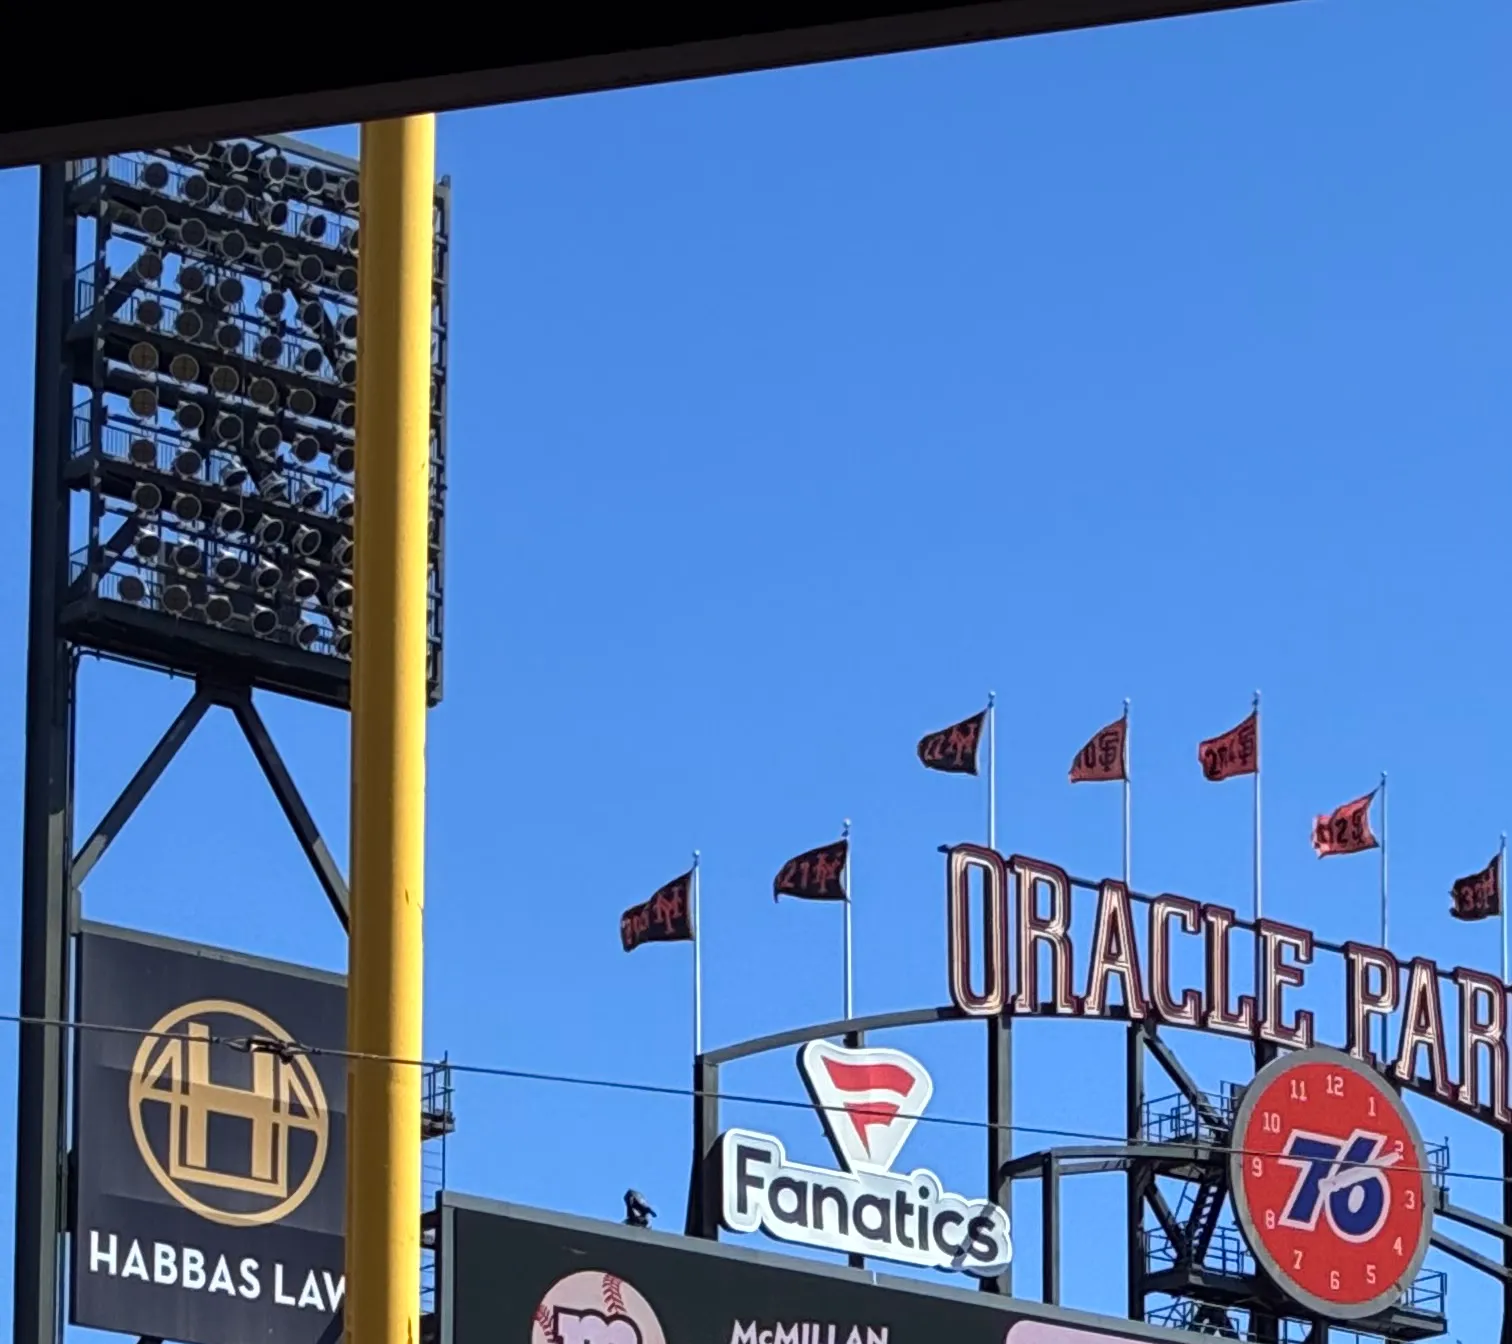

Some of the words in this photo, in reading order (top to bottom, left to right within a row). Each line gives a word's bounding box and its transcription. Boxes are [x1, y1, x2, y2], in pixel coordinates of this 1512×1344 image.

[946, 842, 1313, 1050] ORACLE
[1290, 1080, 1307, 1100] 11
[1326, 1074, 1344, 1095] 12
[1263, 1113, 1281, 1133] 10
[1252, 1157, 1263, 1177] 9
[1277, 1126, 1390, 1245] 76
[736, 1145, 998, 1262] Fanatics
[1405, 1190, 1415, 1210] 3
[90, 1230, 260, 1299] HABBAS
[1330, 1271, 1340, 1290] 6
